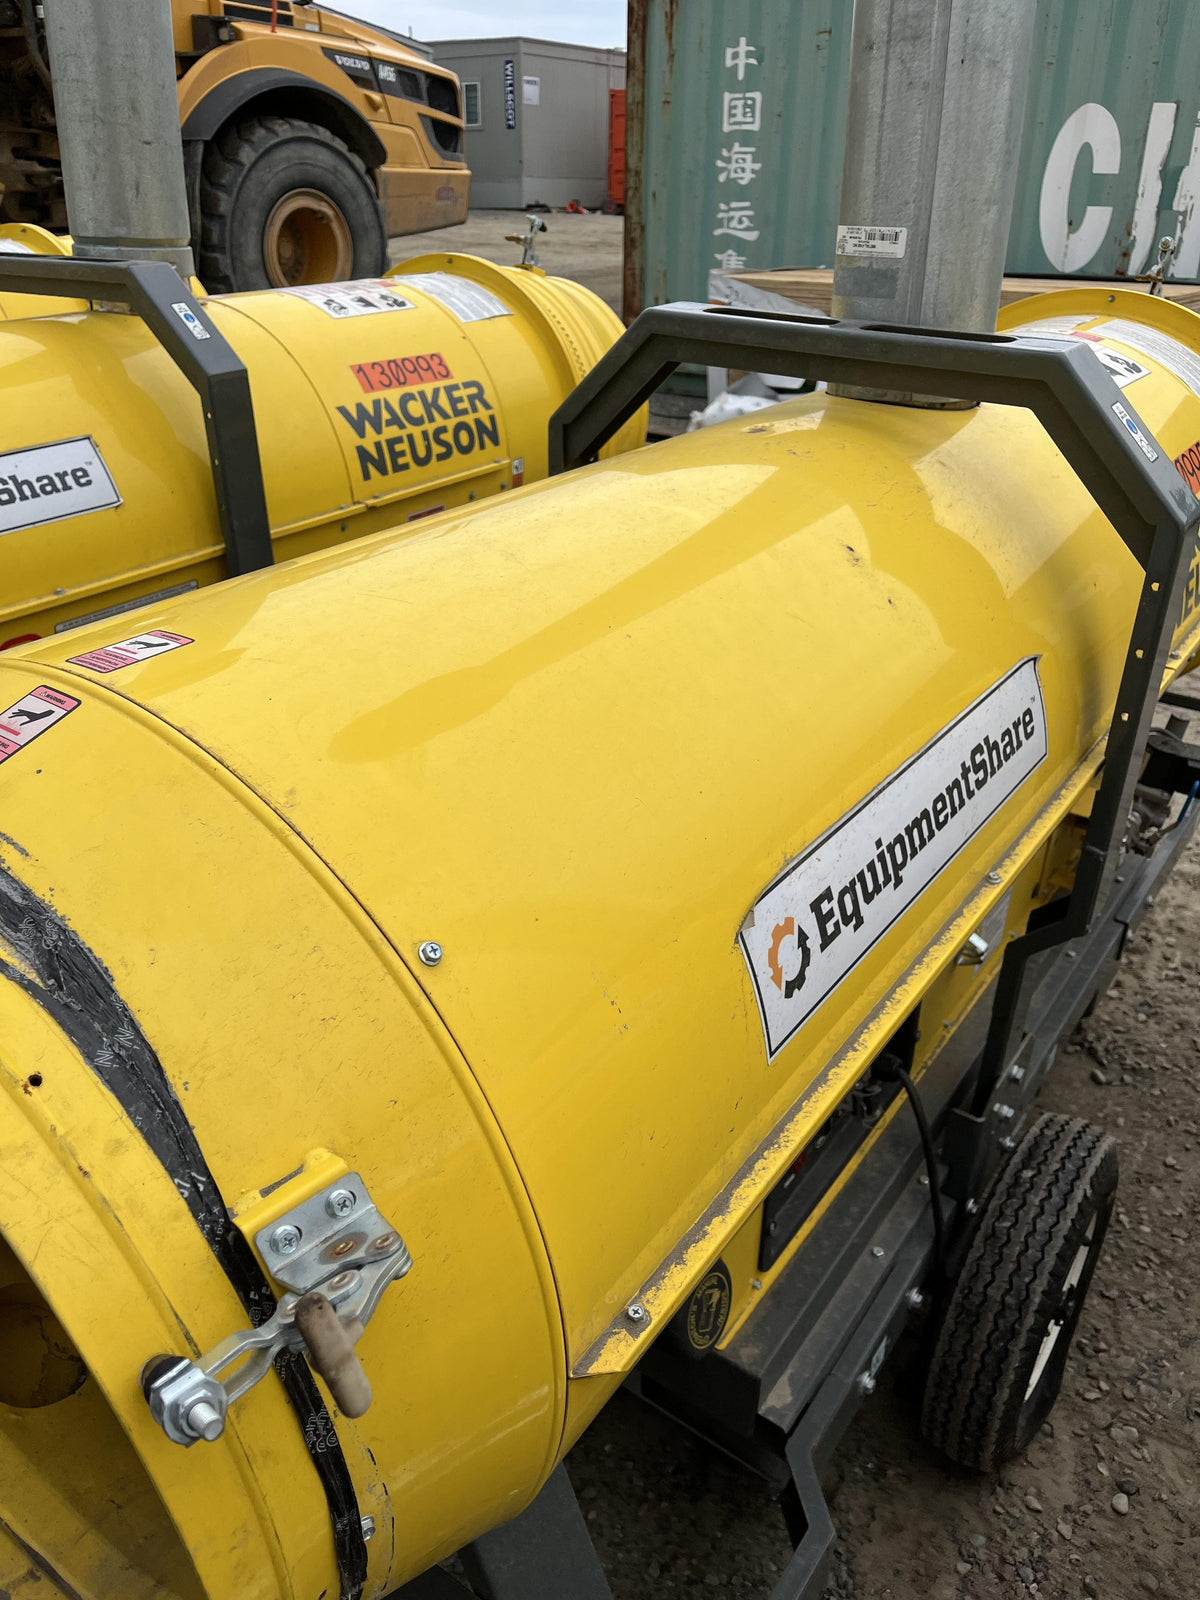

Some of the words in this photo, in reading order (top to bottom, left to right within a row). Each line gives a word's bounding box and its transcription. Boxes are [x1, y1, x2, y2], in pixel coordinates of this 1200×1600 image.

[356, 353, 450, 391] 130993
[335, 380, 493, 439] WACKER
[355, 414, 501, 482] NEUSON
[808, 707, 1035, 954] EquipmentShare
